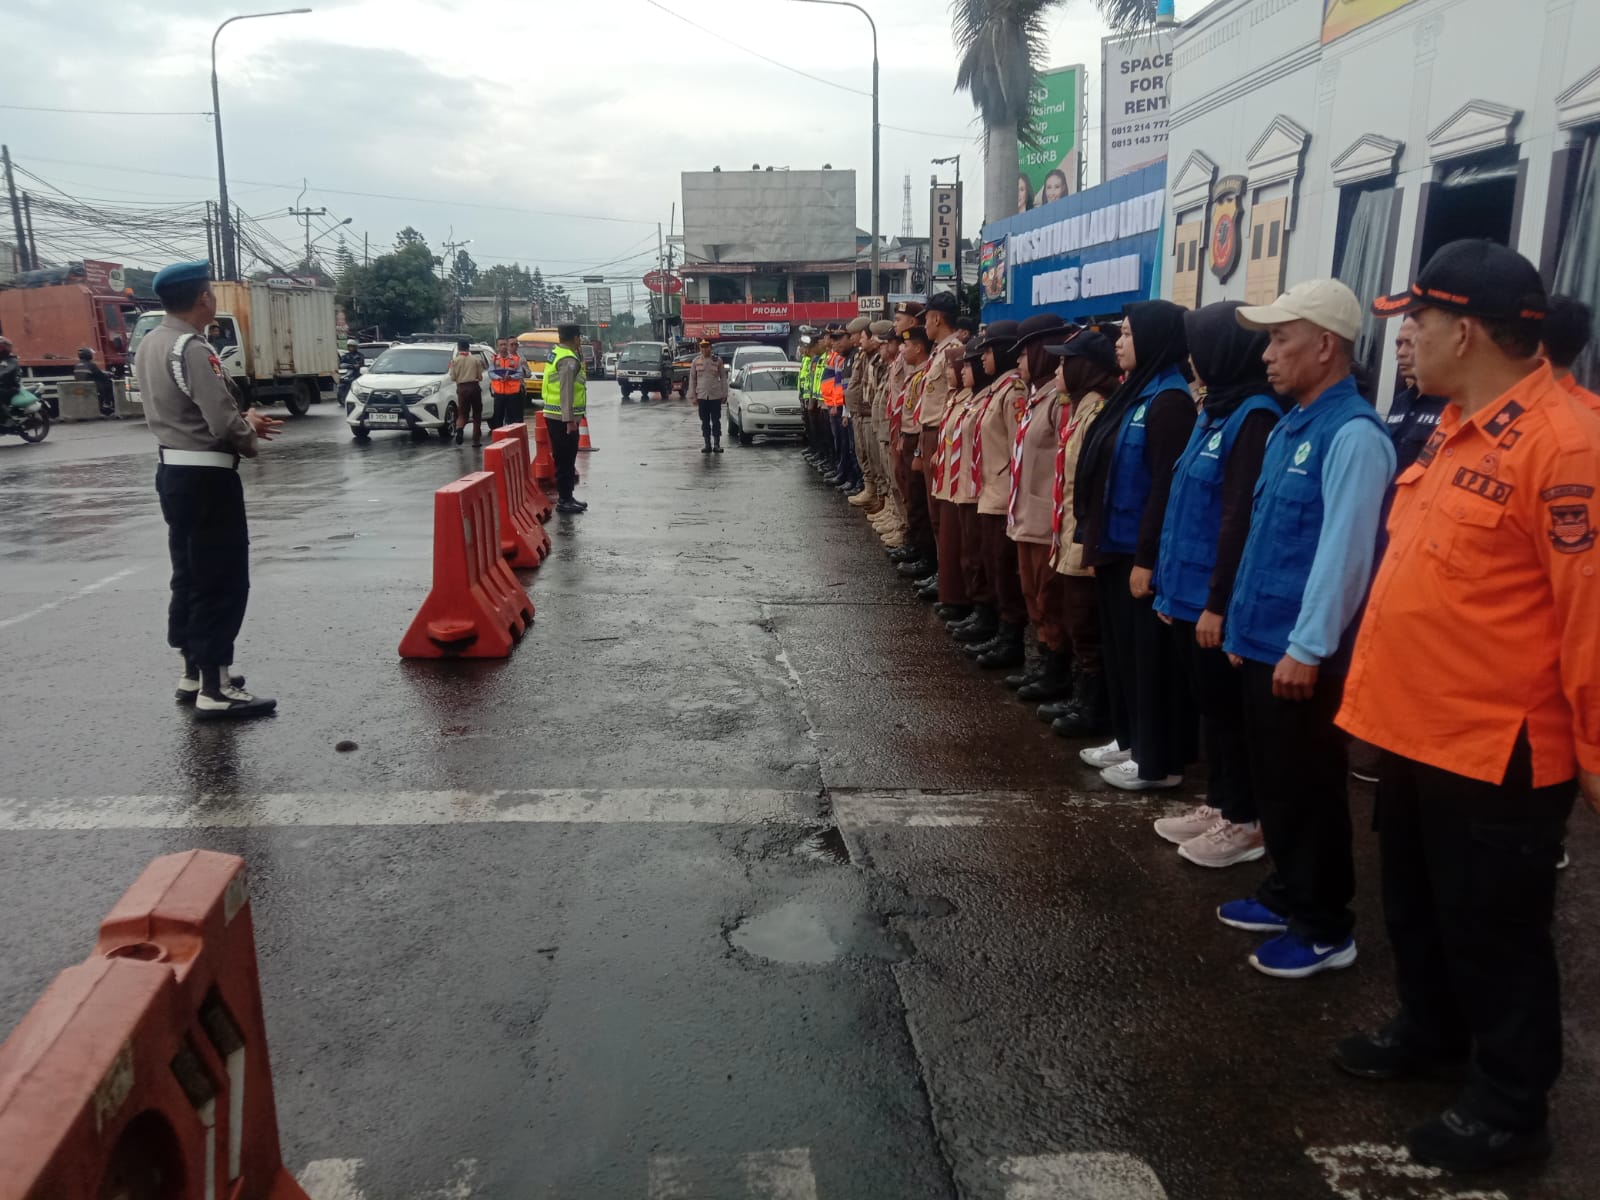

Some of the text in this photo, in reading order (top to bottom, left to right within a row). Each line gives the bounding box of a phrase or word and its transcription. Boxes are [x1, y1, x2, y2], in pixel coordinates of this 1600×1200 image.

[1120, 53, 1173, 75] SPACE
[1130, 75, 1164, 94] FOR
[1124, 96, 1167, 115] RENT
[1111, 125, 1132, 136] 0812
[1134, 122, 1151, 132] 214
[1111, 138, 1132, 149] 0813
[1135, 135, 1151, 145] 143
[937, 193, 952, 259] POLISI
[752, 306, 788, 315] PROBAN
